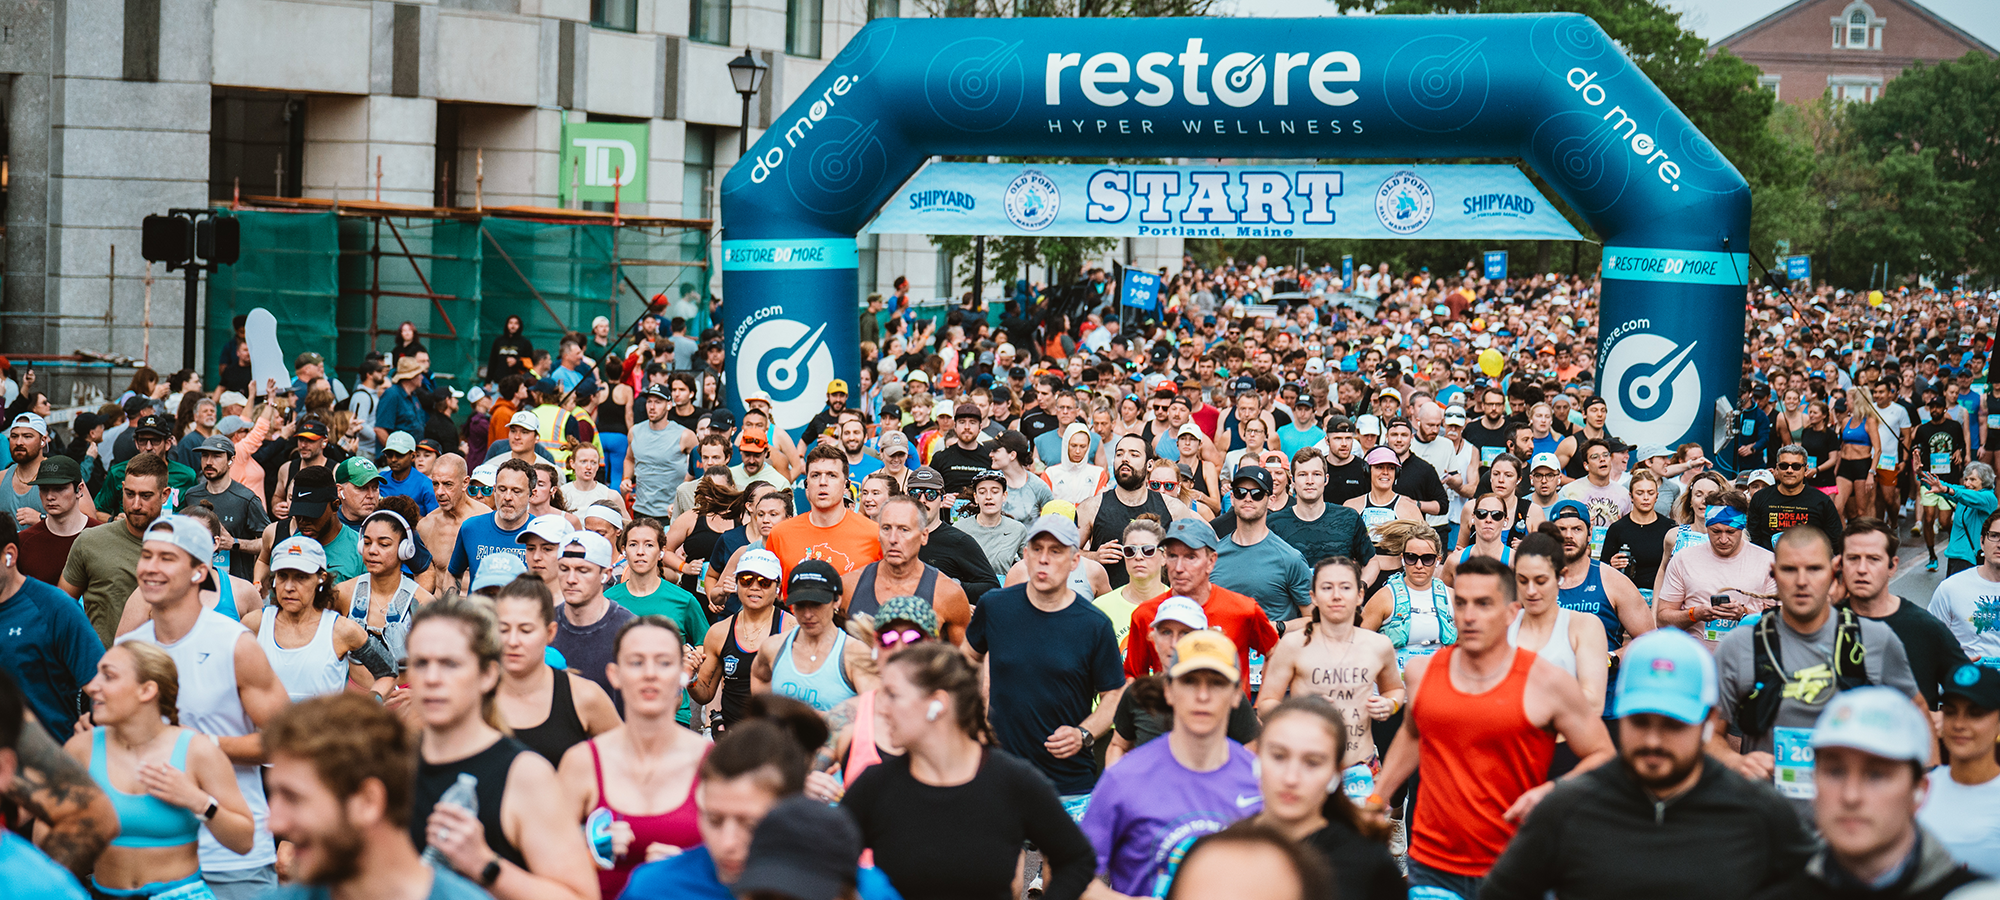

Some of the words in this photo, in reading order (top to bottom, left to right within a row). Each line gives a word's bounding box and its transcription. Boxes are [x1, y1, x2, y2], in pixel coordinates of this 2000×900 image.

[1045, 38, 1361, 108] restore
[751, 147, 783, 184] do
[785, 75, 859, 148] more.
[1048, 119, 1154, 134] HYPER
[1182, 119, 1363, 134] WELLNESS
[1567, 67, 1606, 106] do
[1603, 105, 1681, 192] more.
[572, 138, 637, 187] TD
[1010, 177, 1028, 195] OLD
[1031, 176, 1056, 196] PORT
[1381, 178, 1400, 197] OLD
[1403, 177, 1429, 197] PORT
[909, 190, 976, 211] SHIPYARD
[1085, 168, 1344, 225] START
[1463, 193, 1534, 215] SHIPYARD
[1137, 225, 1225, 238] Portland,
[1236, 226, 1294, 237] Maine
[725, 246, 825, 263] #RESTOREDOMORE
[1608, 255, 1718, 276] #RESTOREDOMORE
[730, 305, 783, 357] restore.com
[1598, 318, 1650, 369] restore.com
[1769, 512, 1778, 528] THE
[1778, 512, 1808, 521] DREAM
[1312, 667, 1369, 685] CANCER
[1329, 688, 1354, 701] CAN
[1352, 708, 1360, 720] A
